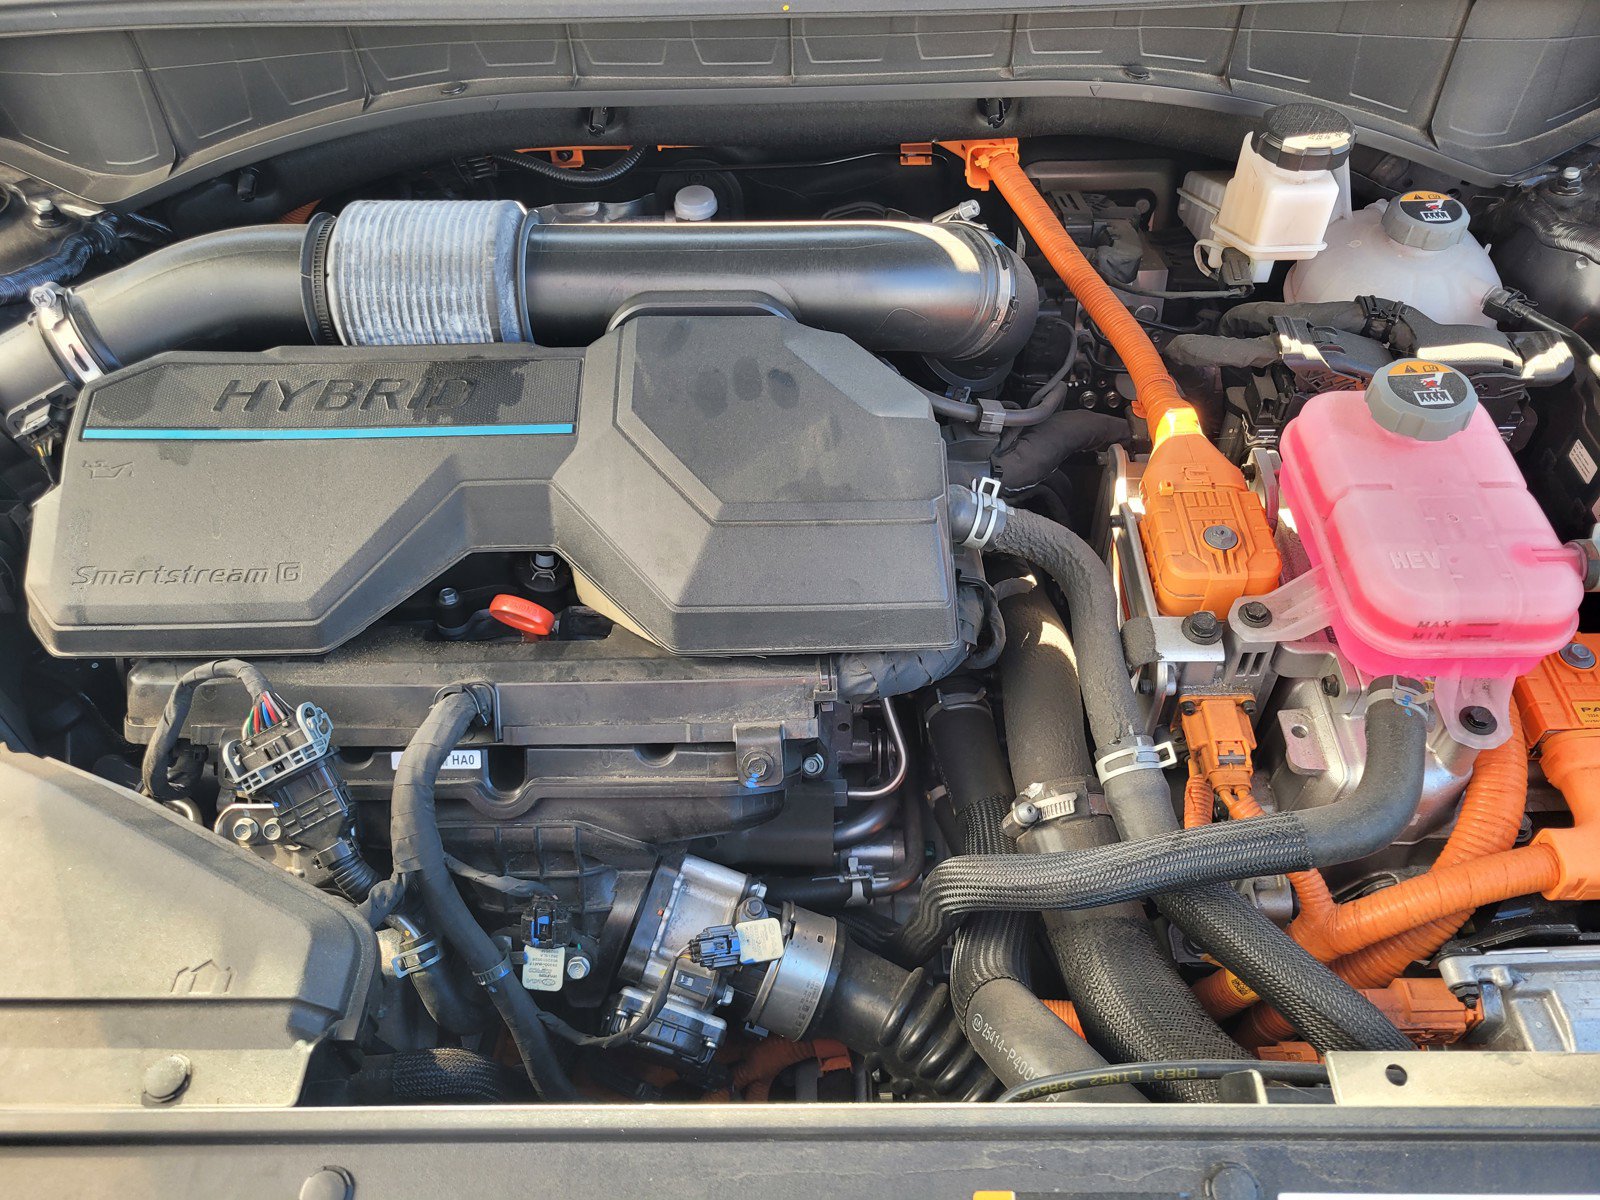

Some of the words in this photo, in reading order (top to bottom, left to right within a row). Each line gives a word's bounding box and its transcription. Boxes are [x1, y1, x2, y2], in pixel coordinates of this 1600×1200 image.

[210, 377, 477, 413] HYBRID
[1388, 551, 1441, 569] HEV
[71, 565, 270, 586] Smartstream
[1416, 620, 1452, 629] MAX
[1411, 631, 1447, 640] MIN
